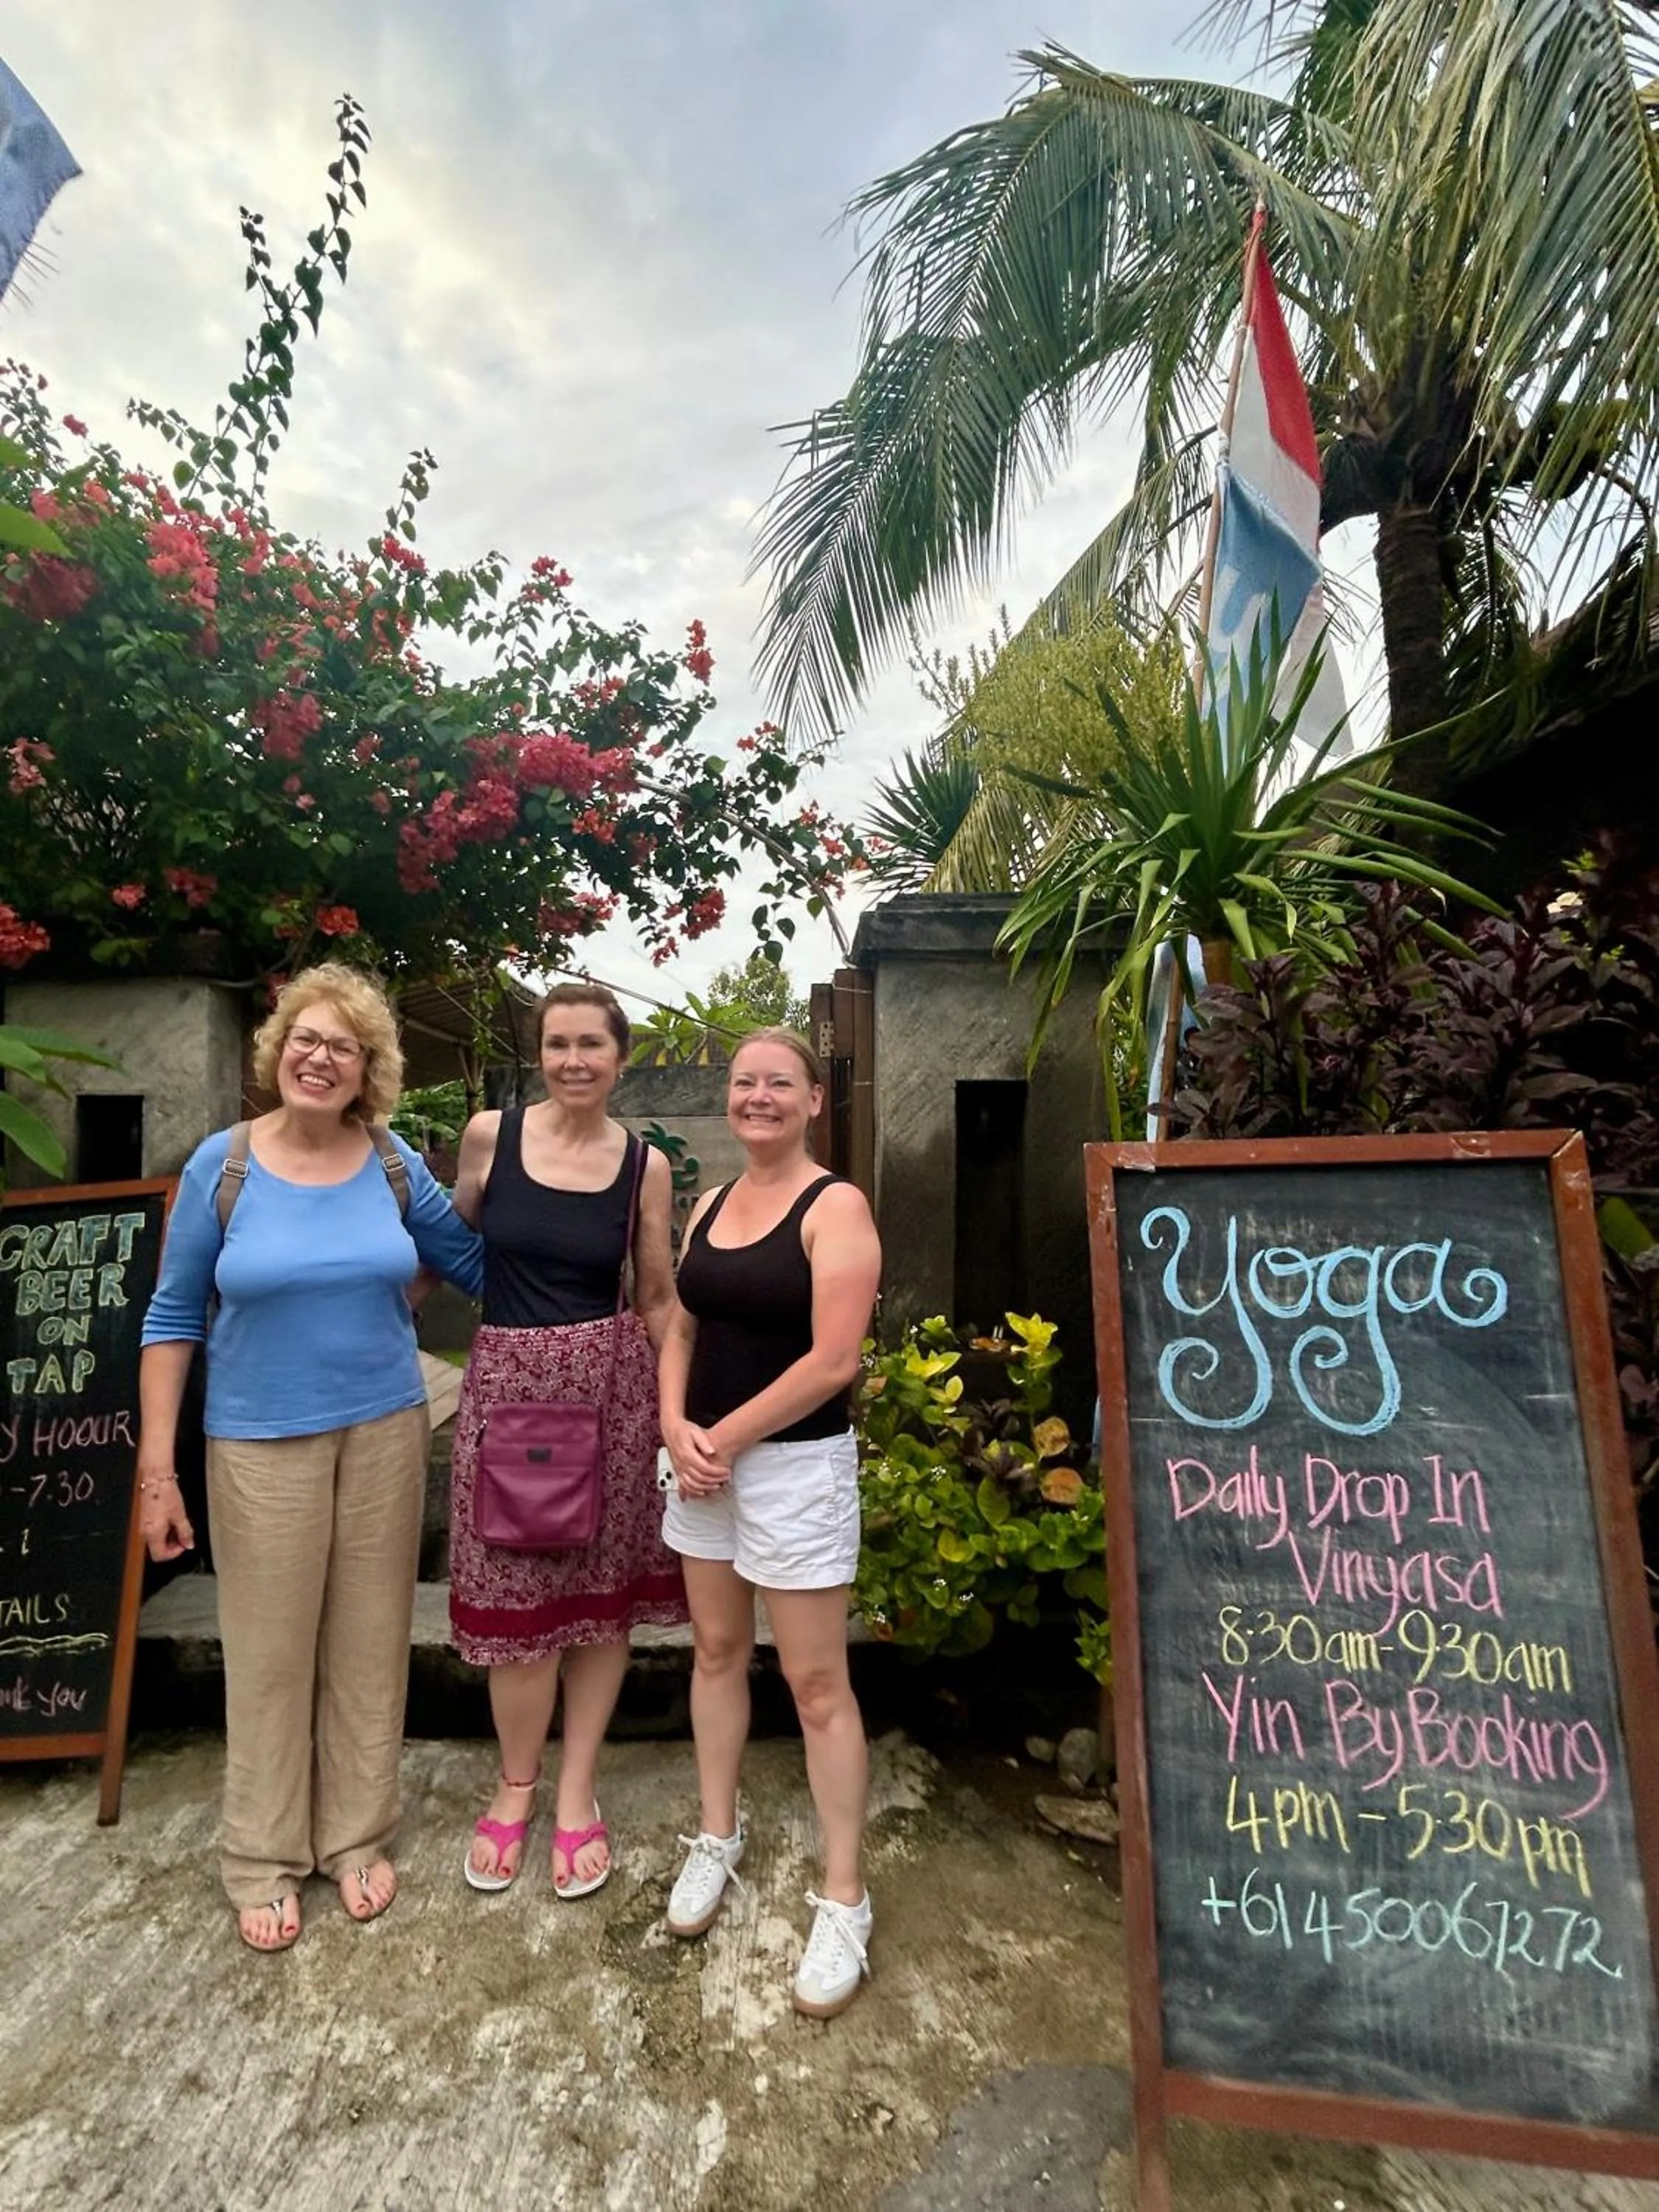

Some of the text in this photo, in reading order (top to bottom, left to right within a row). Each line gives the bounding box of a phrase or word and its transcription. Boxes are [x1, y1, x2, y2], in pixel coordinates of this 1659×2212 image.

[0, 1211, 145, 1271] CRAFT
[13, 1262, 131, 1315] BEER
[1140, 1206, 1508, 1436] Yoga
[7, 1349, 95, 1394] TAP
[37, 1315, 93, 1346] ON
[1166, 1444, 1492, 1551] Daily Drop In
[1287, 1524, 1506, 1638] Vinyasa
[1201, 1672, 1610, 1822] Yin By Booking
